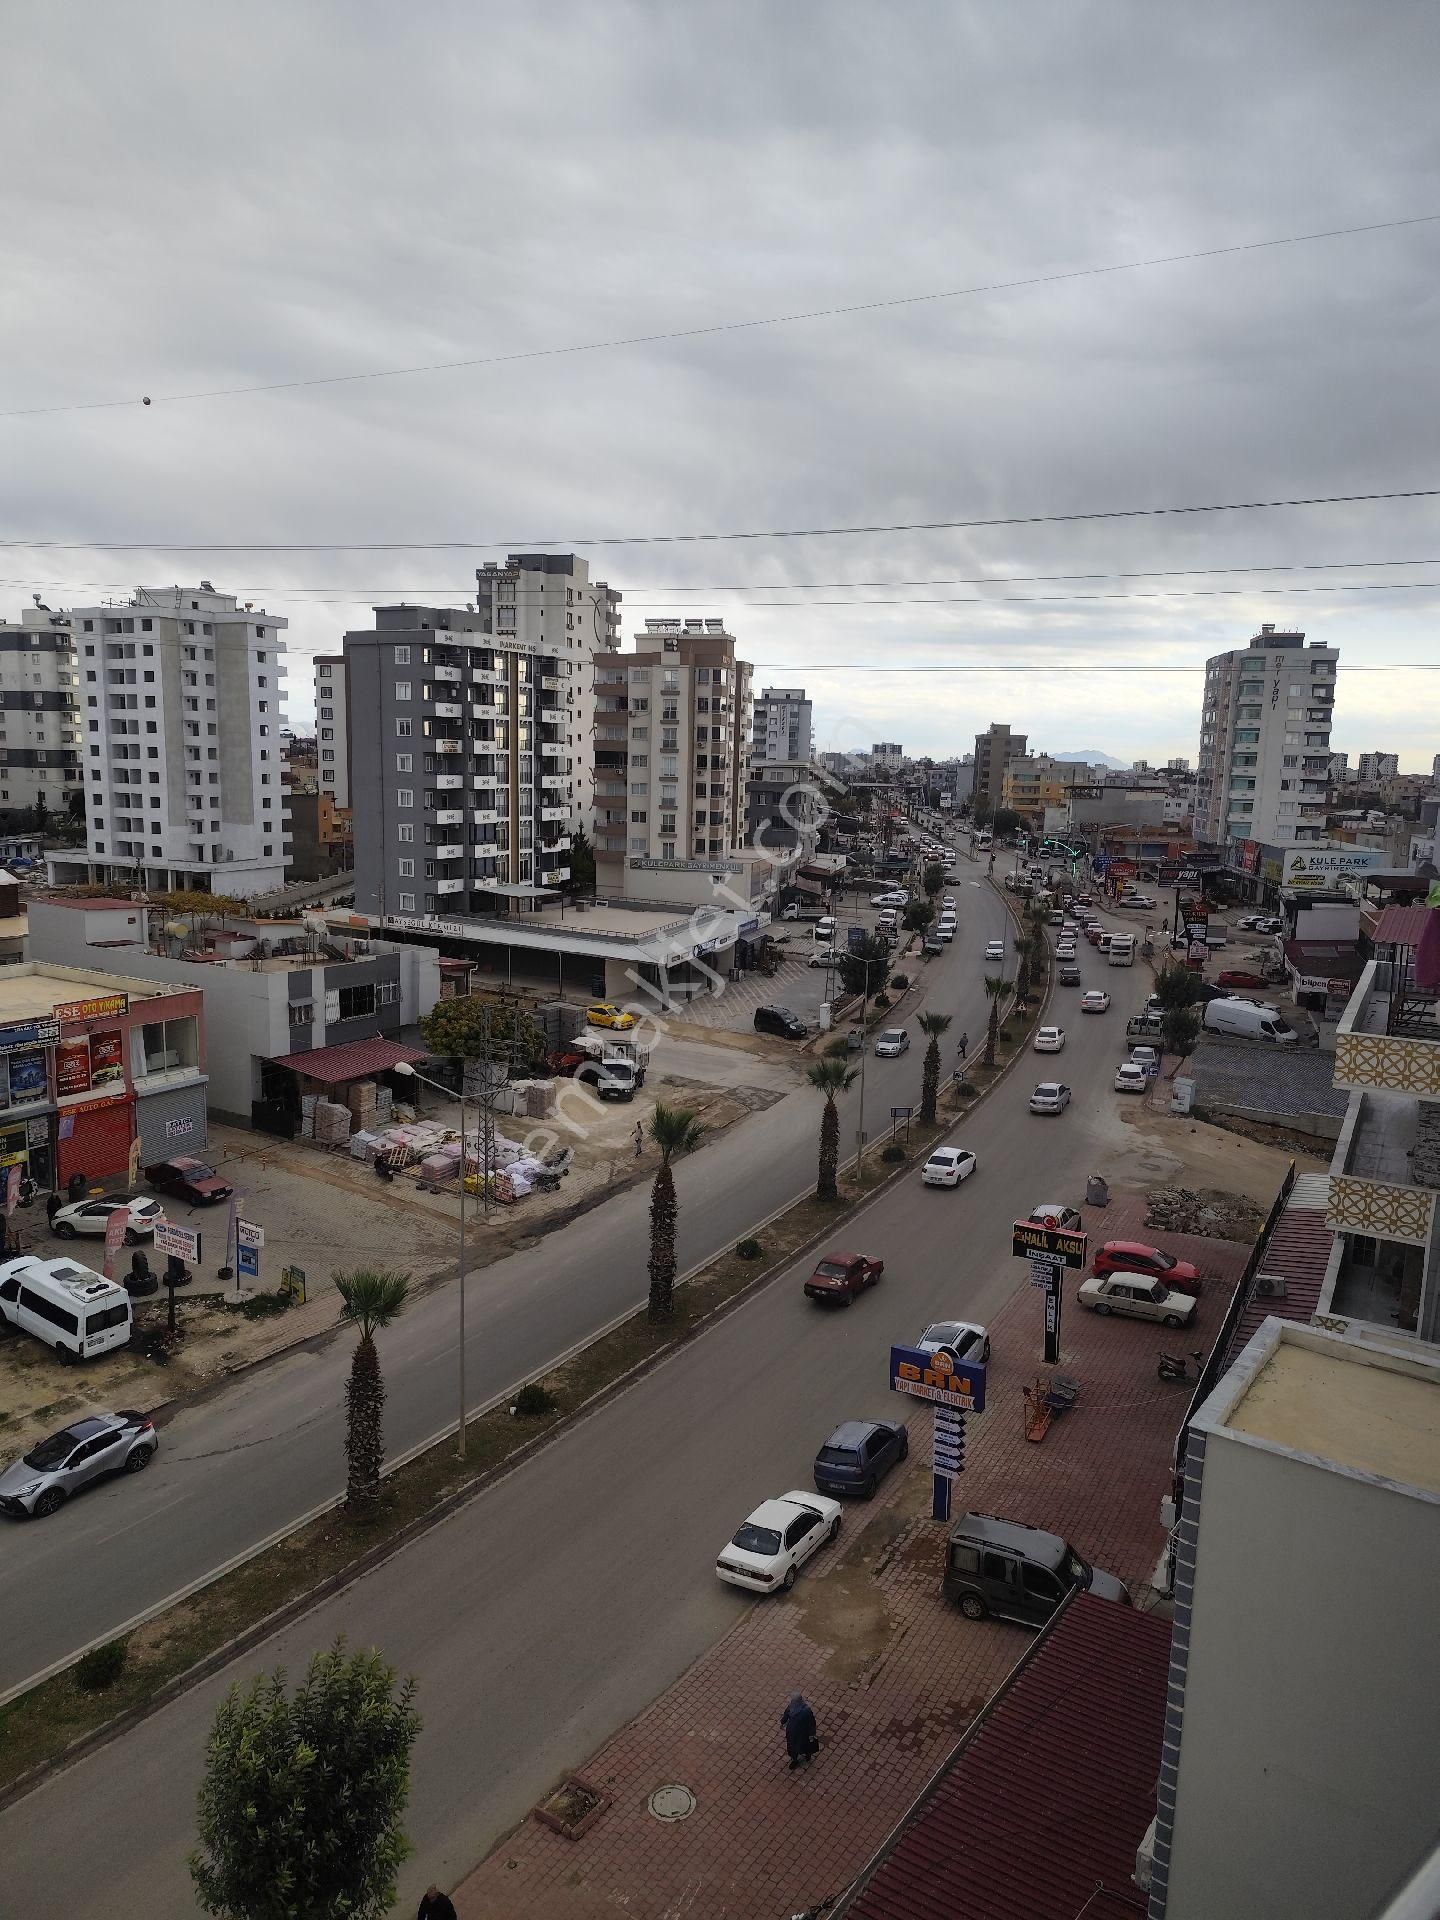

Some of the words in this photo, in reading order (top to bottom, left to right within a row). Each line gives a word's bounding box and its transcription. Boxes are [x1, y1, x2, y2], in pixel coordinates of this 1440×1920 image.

[1309, 857, 1337, 865] KULE
[1340, 858, 1369, 866] PARK
[55, 1007, 81, 1019] ESE
[82, 1003, 97, 1014] OTO
[1056, 1238, 1083, 1255] AKSU
[1047, 1296, 1055, 1331] EMLAK
[899, 1361, 971, 1395] BRN
[895, 1378, 910, 1393] YAPI
[911, 1382, 936, 1399] MARKET
